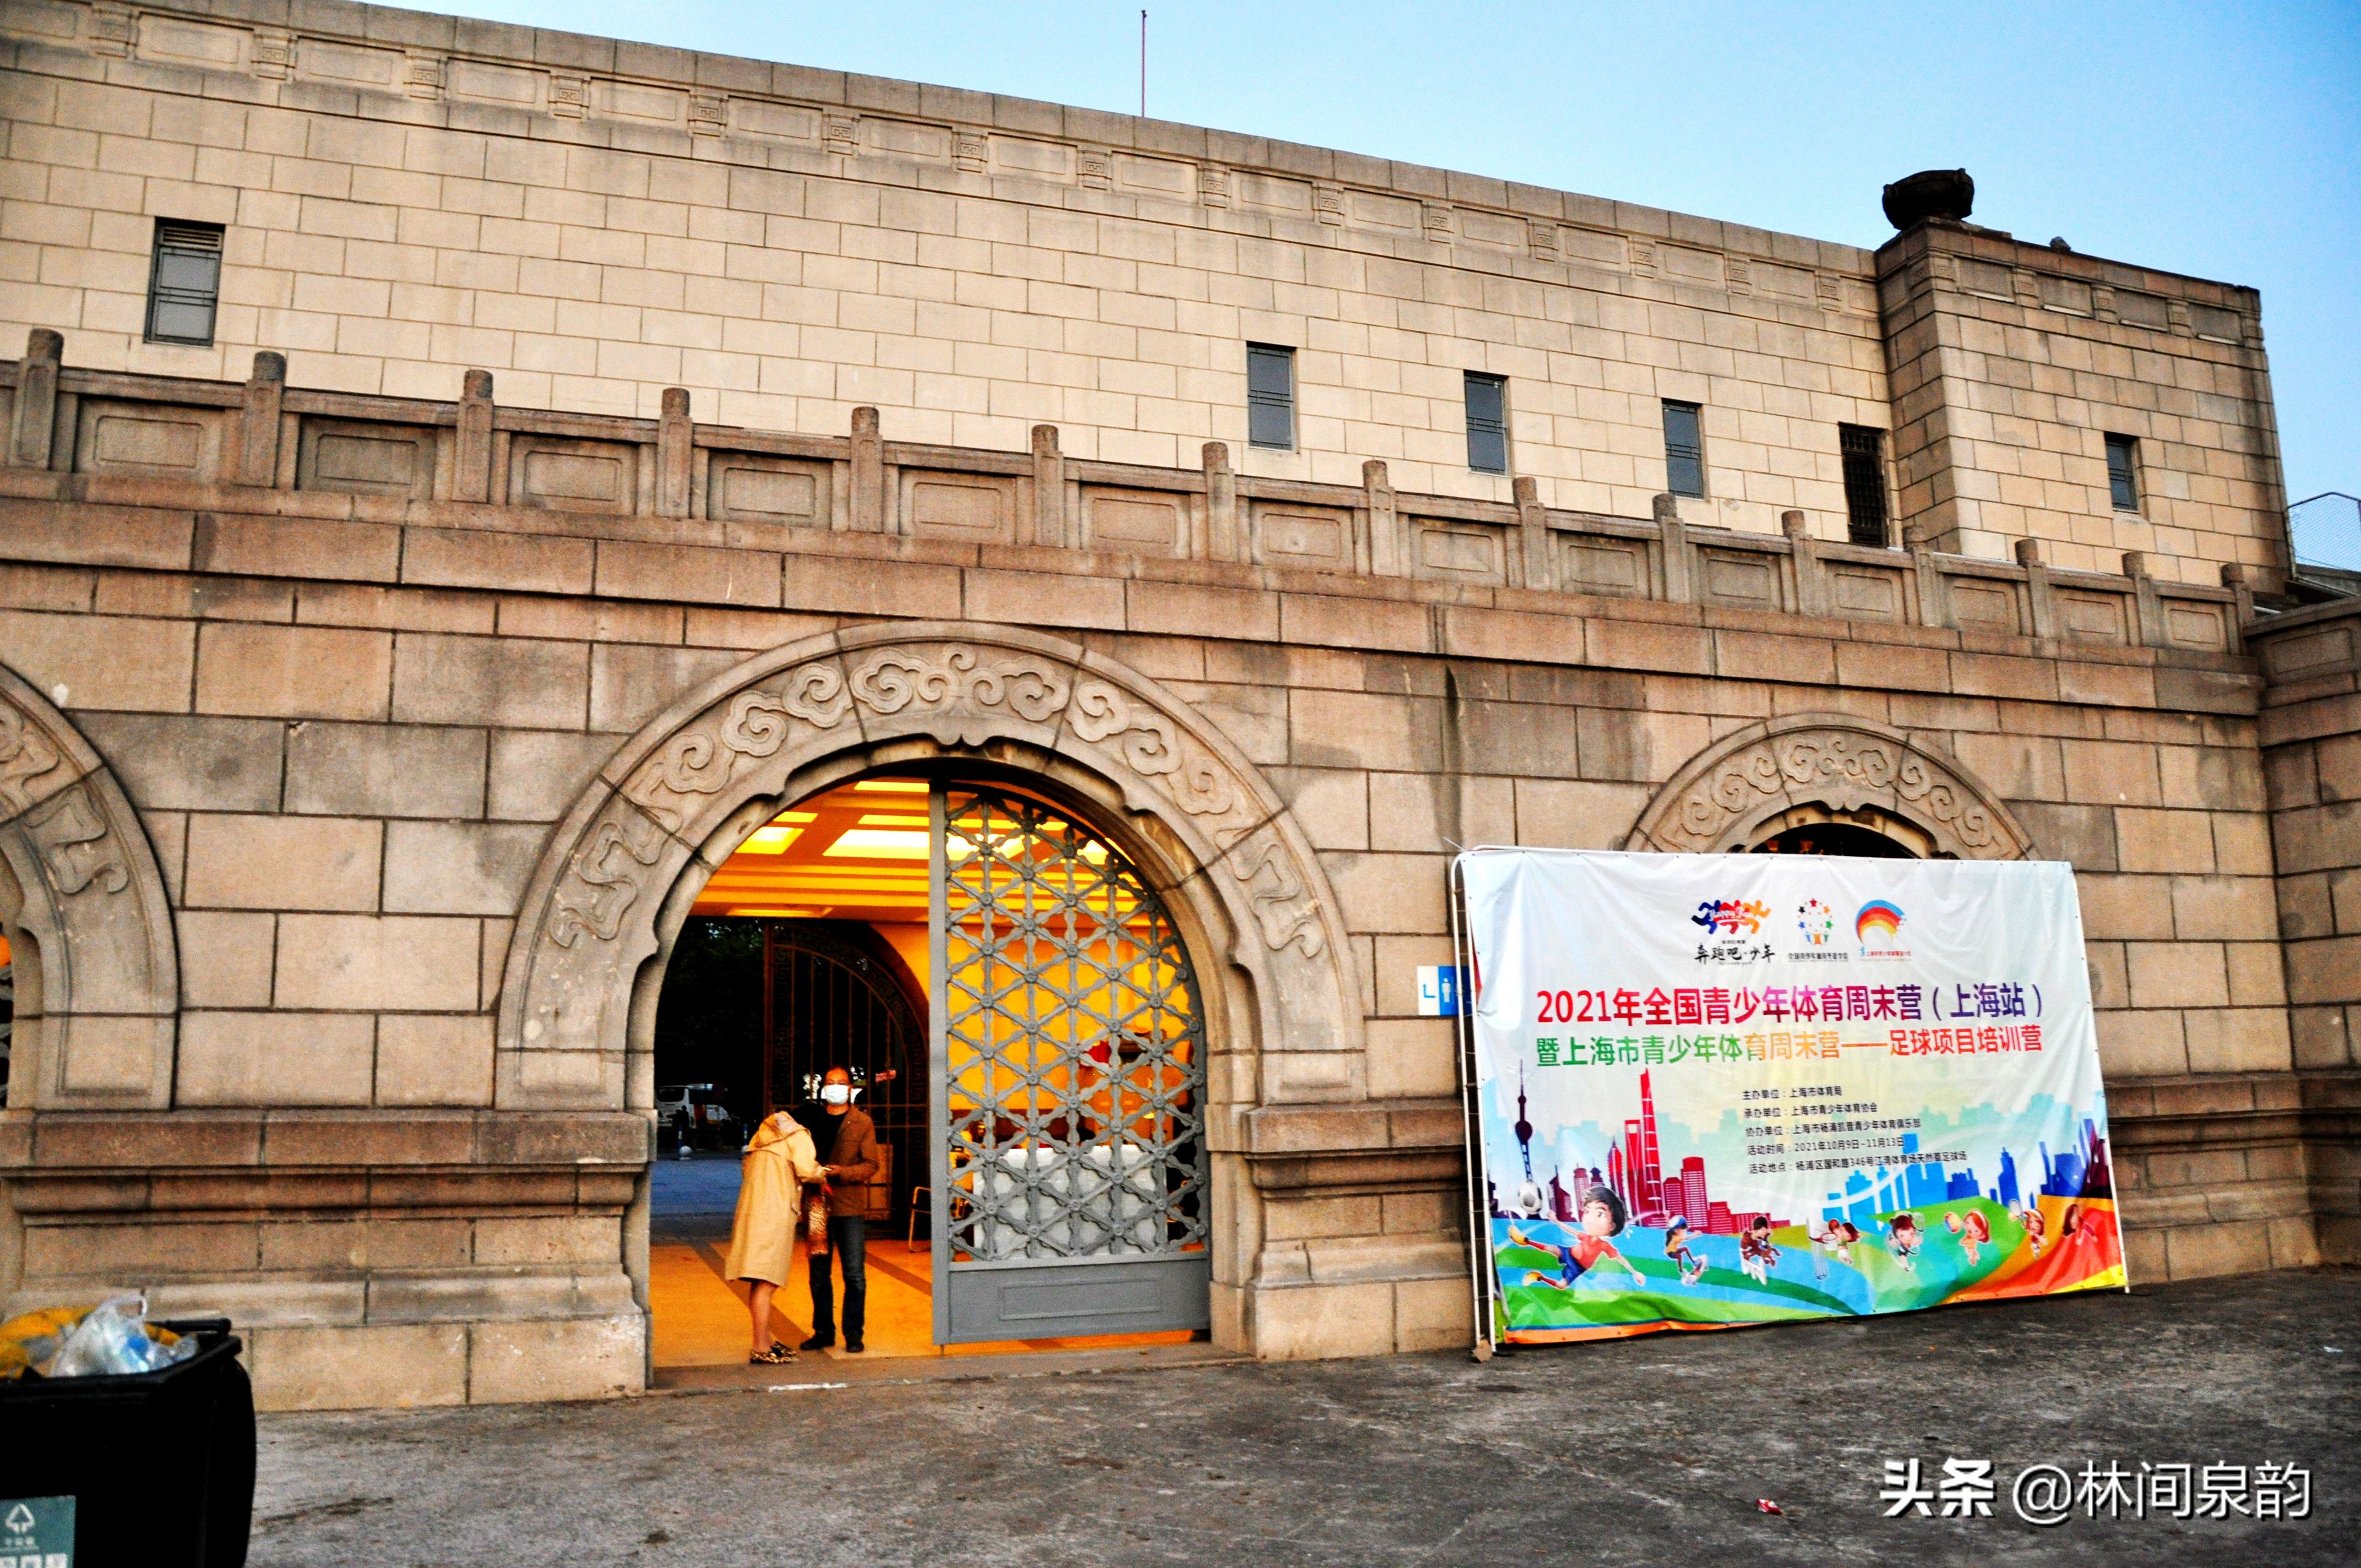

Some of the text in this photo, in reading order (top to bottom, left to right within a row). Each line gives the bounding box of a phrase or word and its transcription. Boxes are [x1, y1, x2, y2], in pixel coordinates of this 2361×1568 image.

[1537, 982, 2042, 1026] 2021年全国青少年体育周末营（上海站）
[1536, 1024, 2042, 1066] 暨上海市青少年体育周末营——足球项目培训营
[1742, 1086, 1843, 1100] 主办单位：上海市体育局
